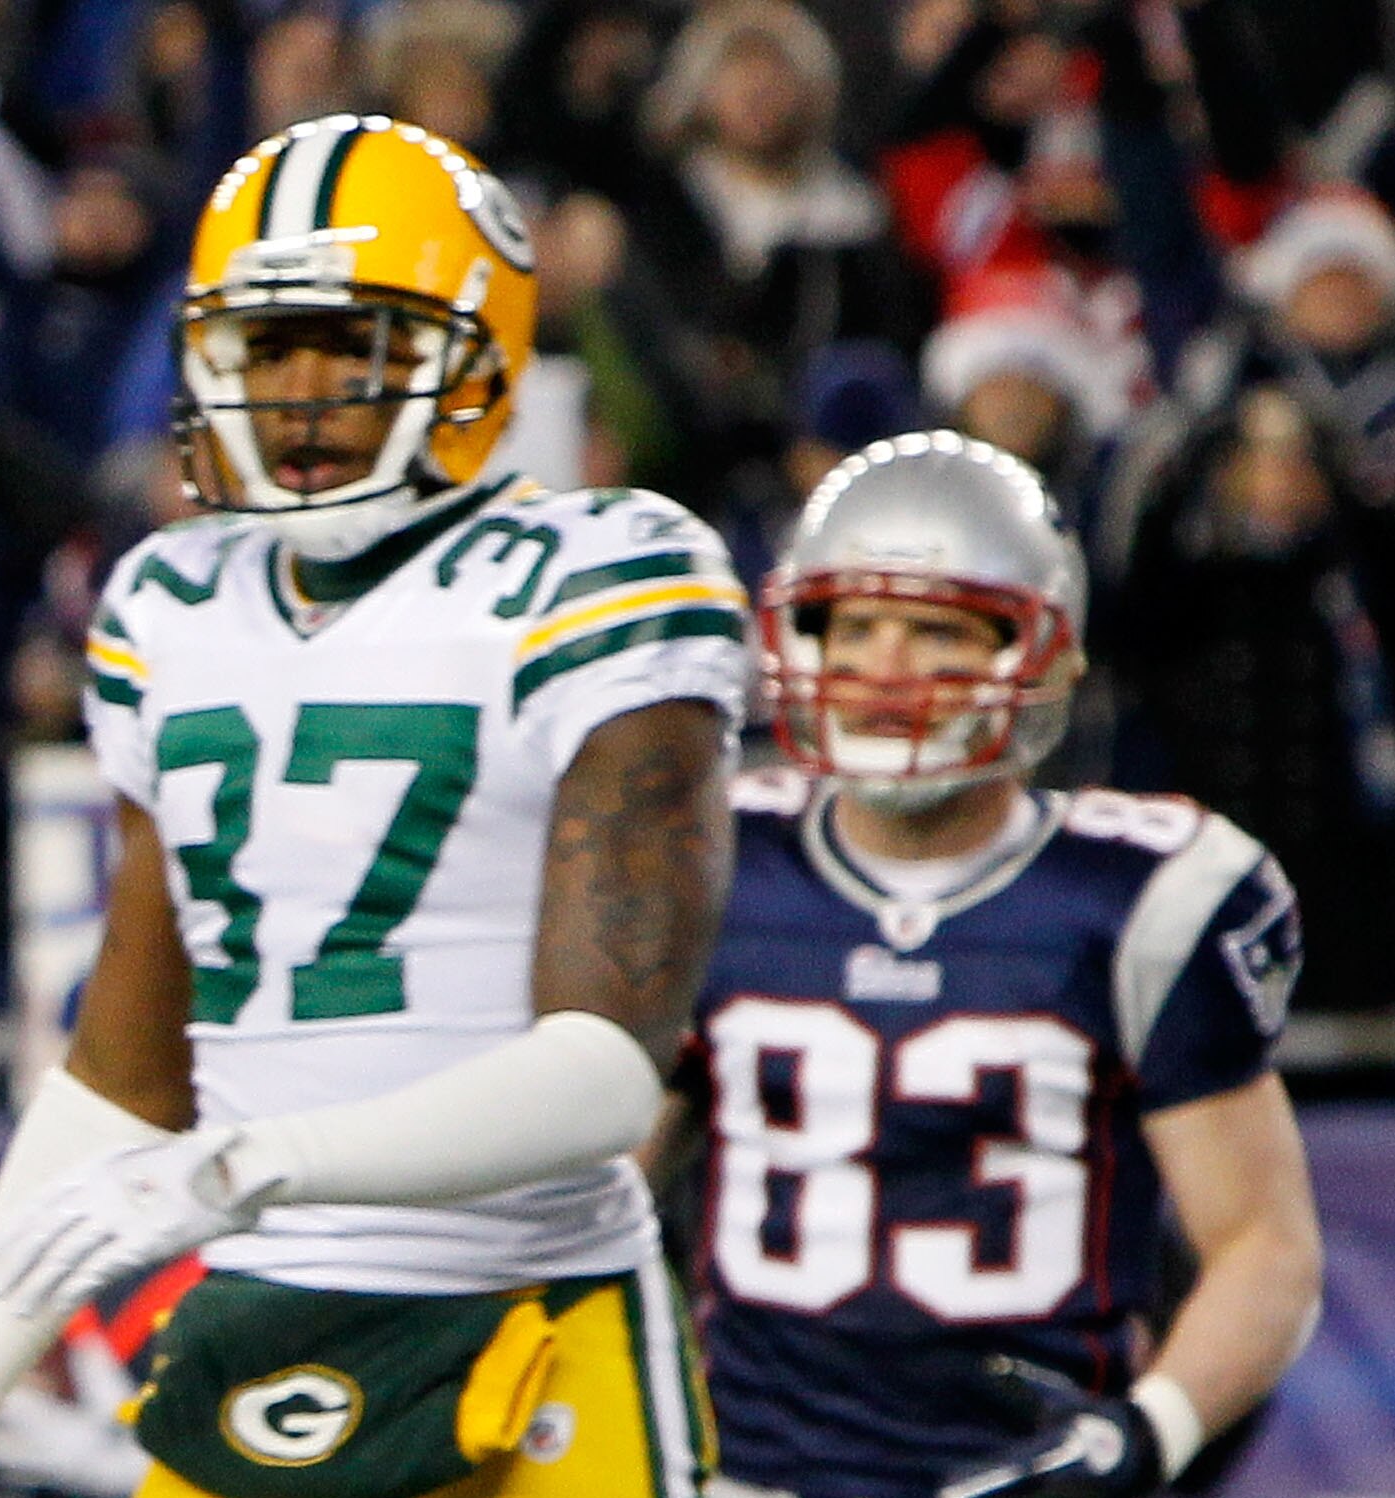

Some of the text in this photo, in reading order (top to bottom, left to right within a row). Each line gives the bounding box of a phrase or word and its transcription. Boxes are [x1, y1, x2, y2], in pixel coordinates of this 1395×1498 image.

[157, 702, 484, 1024] 37
[706, 994, 1096, 1322] 83
[229, 1371, 353, 1462] G
